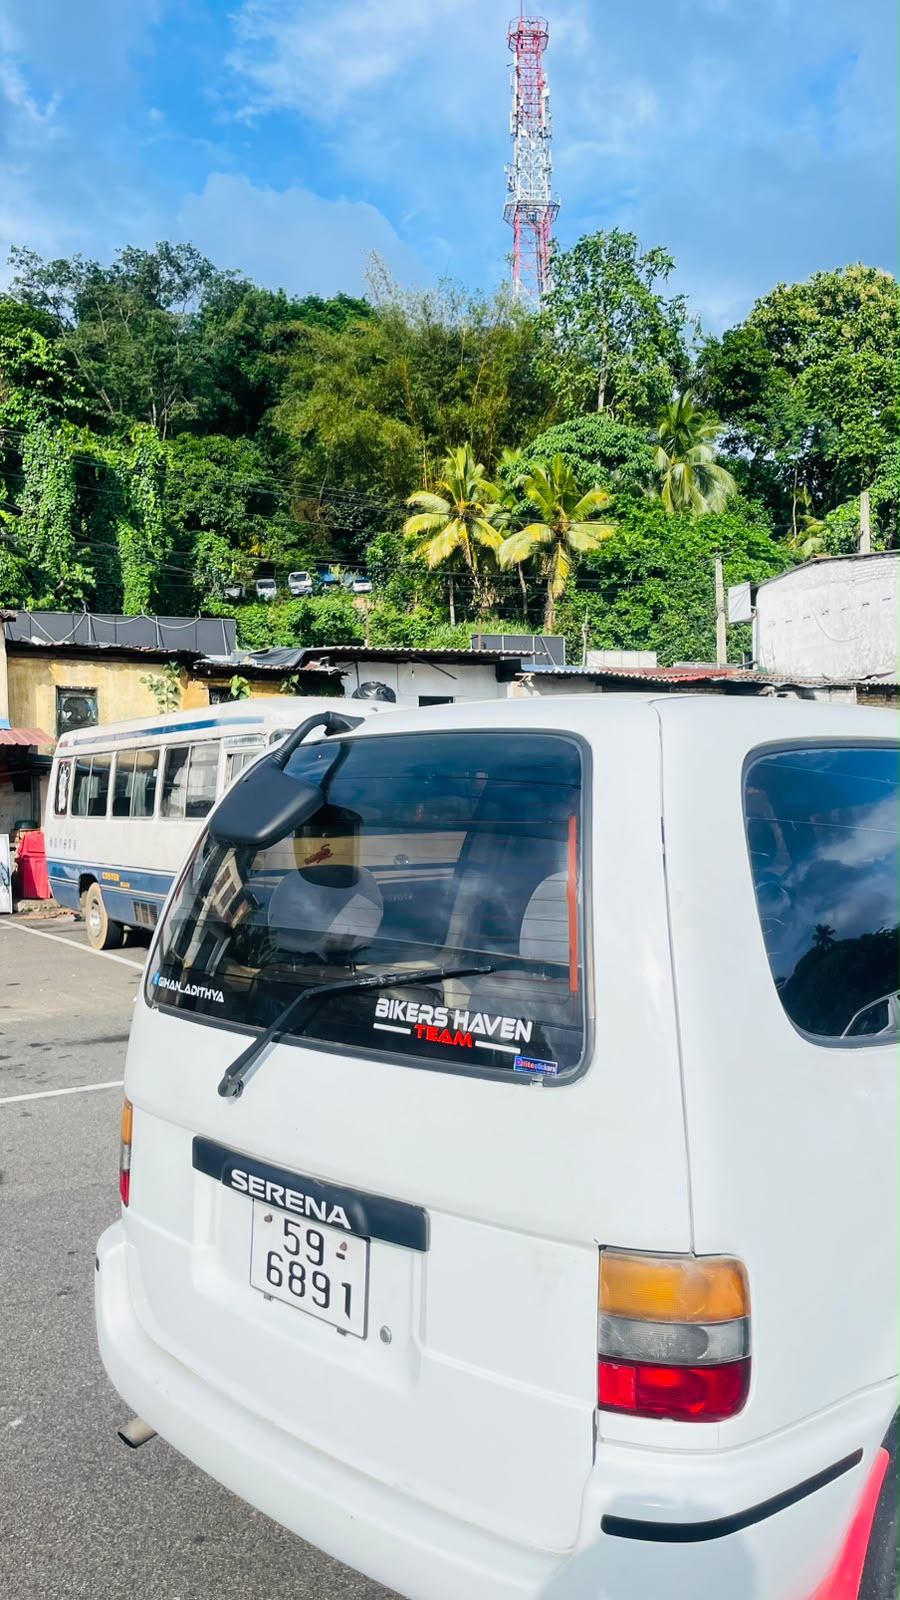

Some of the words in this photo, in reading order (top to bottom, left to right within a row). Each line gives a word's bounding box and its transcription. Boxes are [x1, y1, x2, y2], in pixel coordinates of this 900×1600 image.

[375, 998, 449, 1028] BIKERS
[452, 1009, 533, 1044] HAVEN
[414, 1024, 473, 1048] TEAM
[231, 1168, 352, 1230] SERENA
[266, 1250, 352, 1320] 6891
